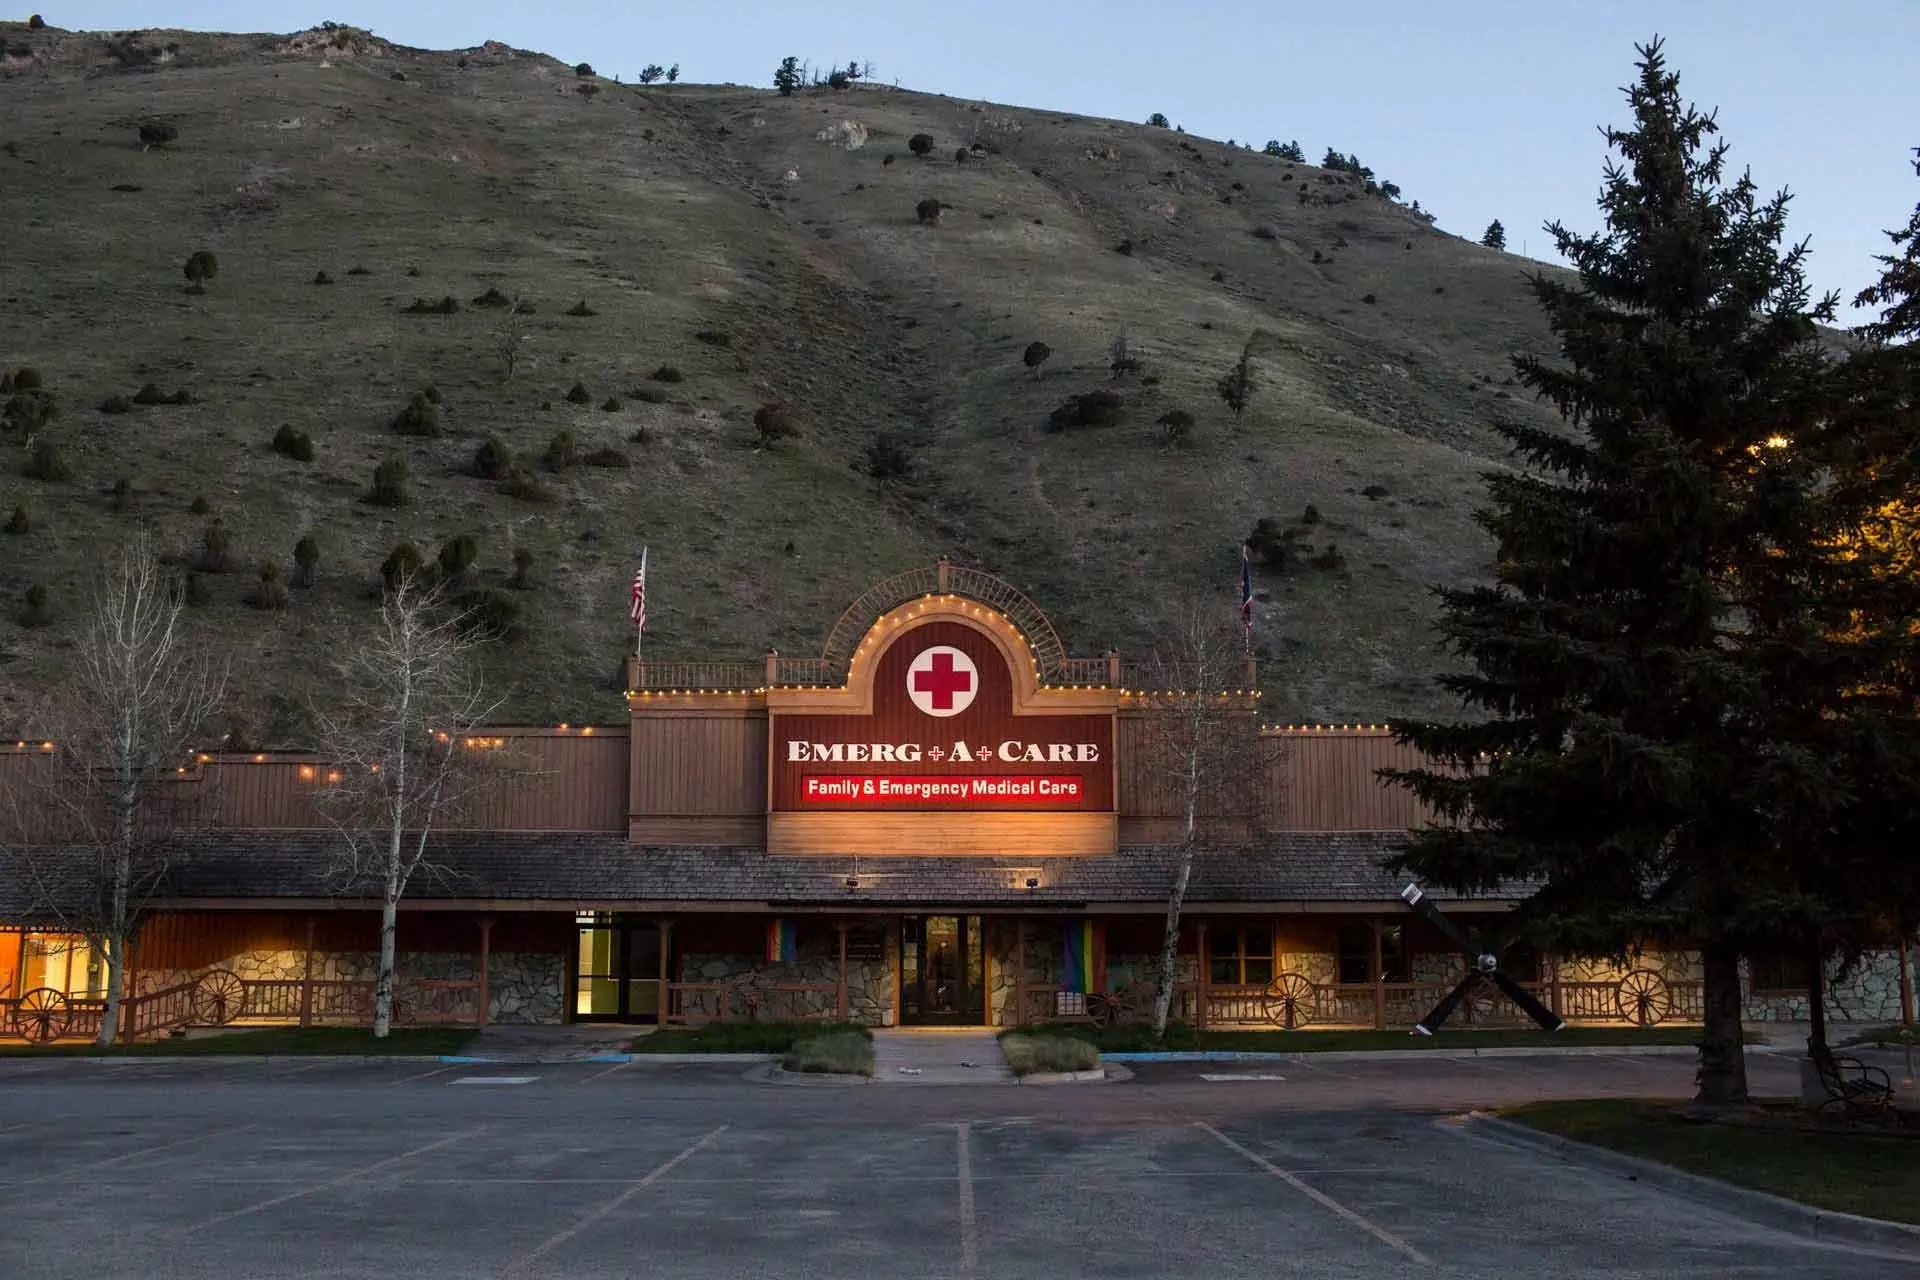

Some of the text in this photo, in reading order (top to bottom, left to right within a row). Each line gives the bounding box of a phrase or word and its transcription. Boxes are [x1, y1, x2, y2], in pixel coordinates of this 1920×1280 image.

[787, 740, 1099, 762] EMERG A CARE
[808, 779, 1077, 799] Family & Emergency Medical Care
